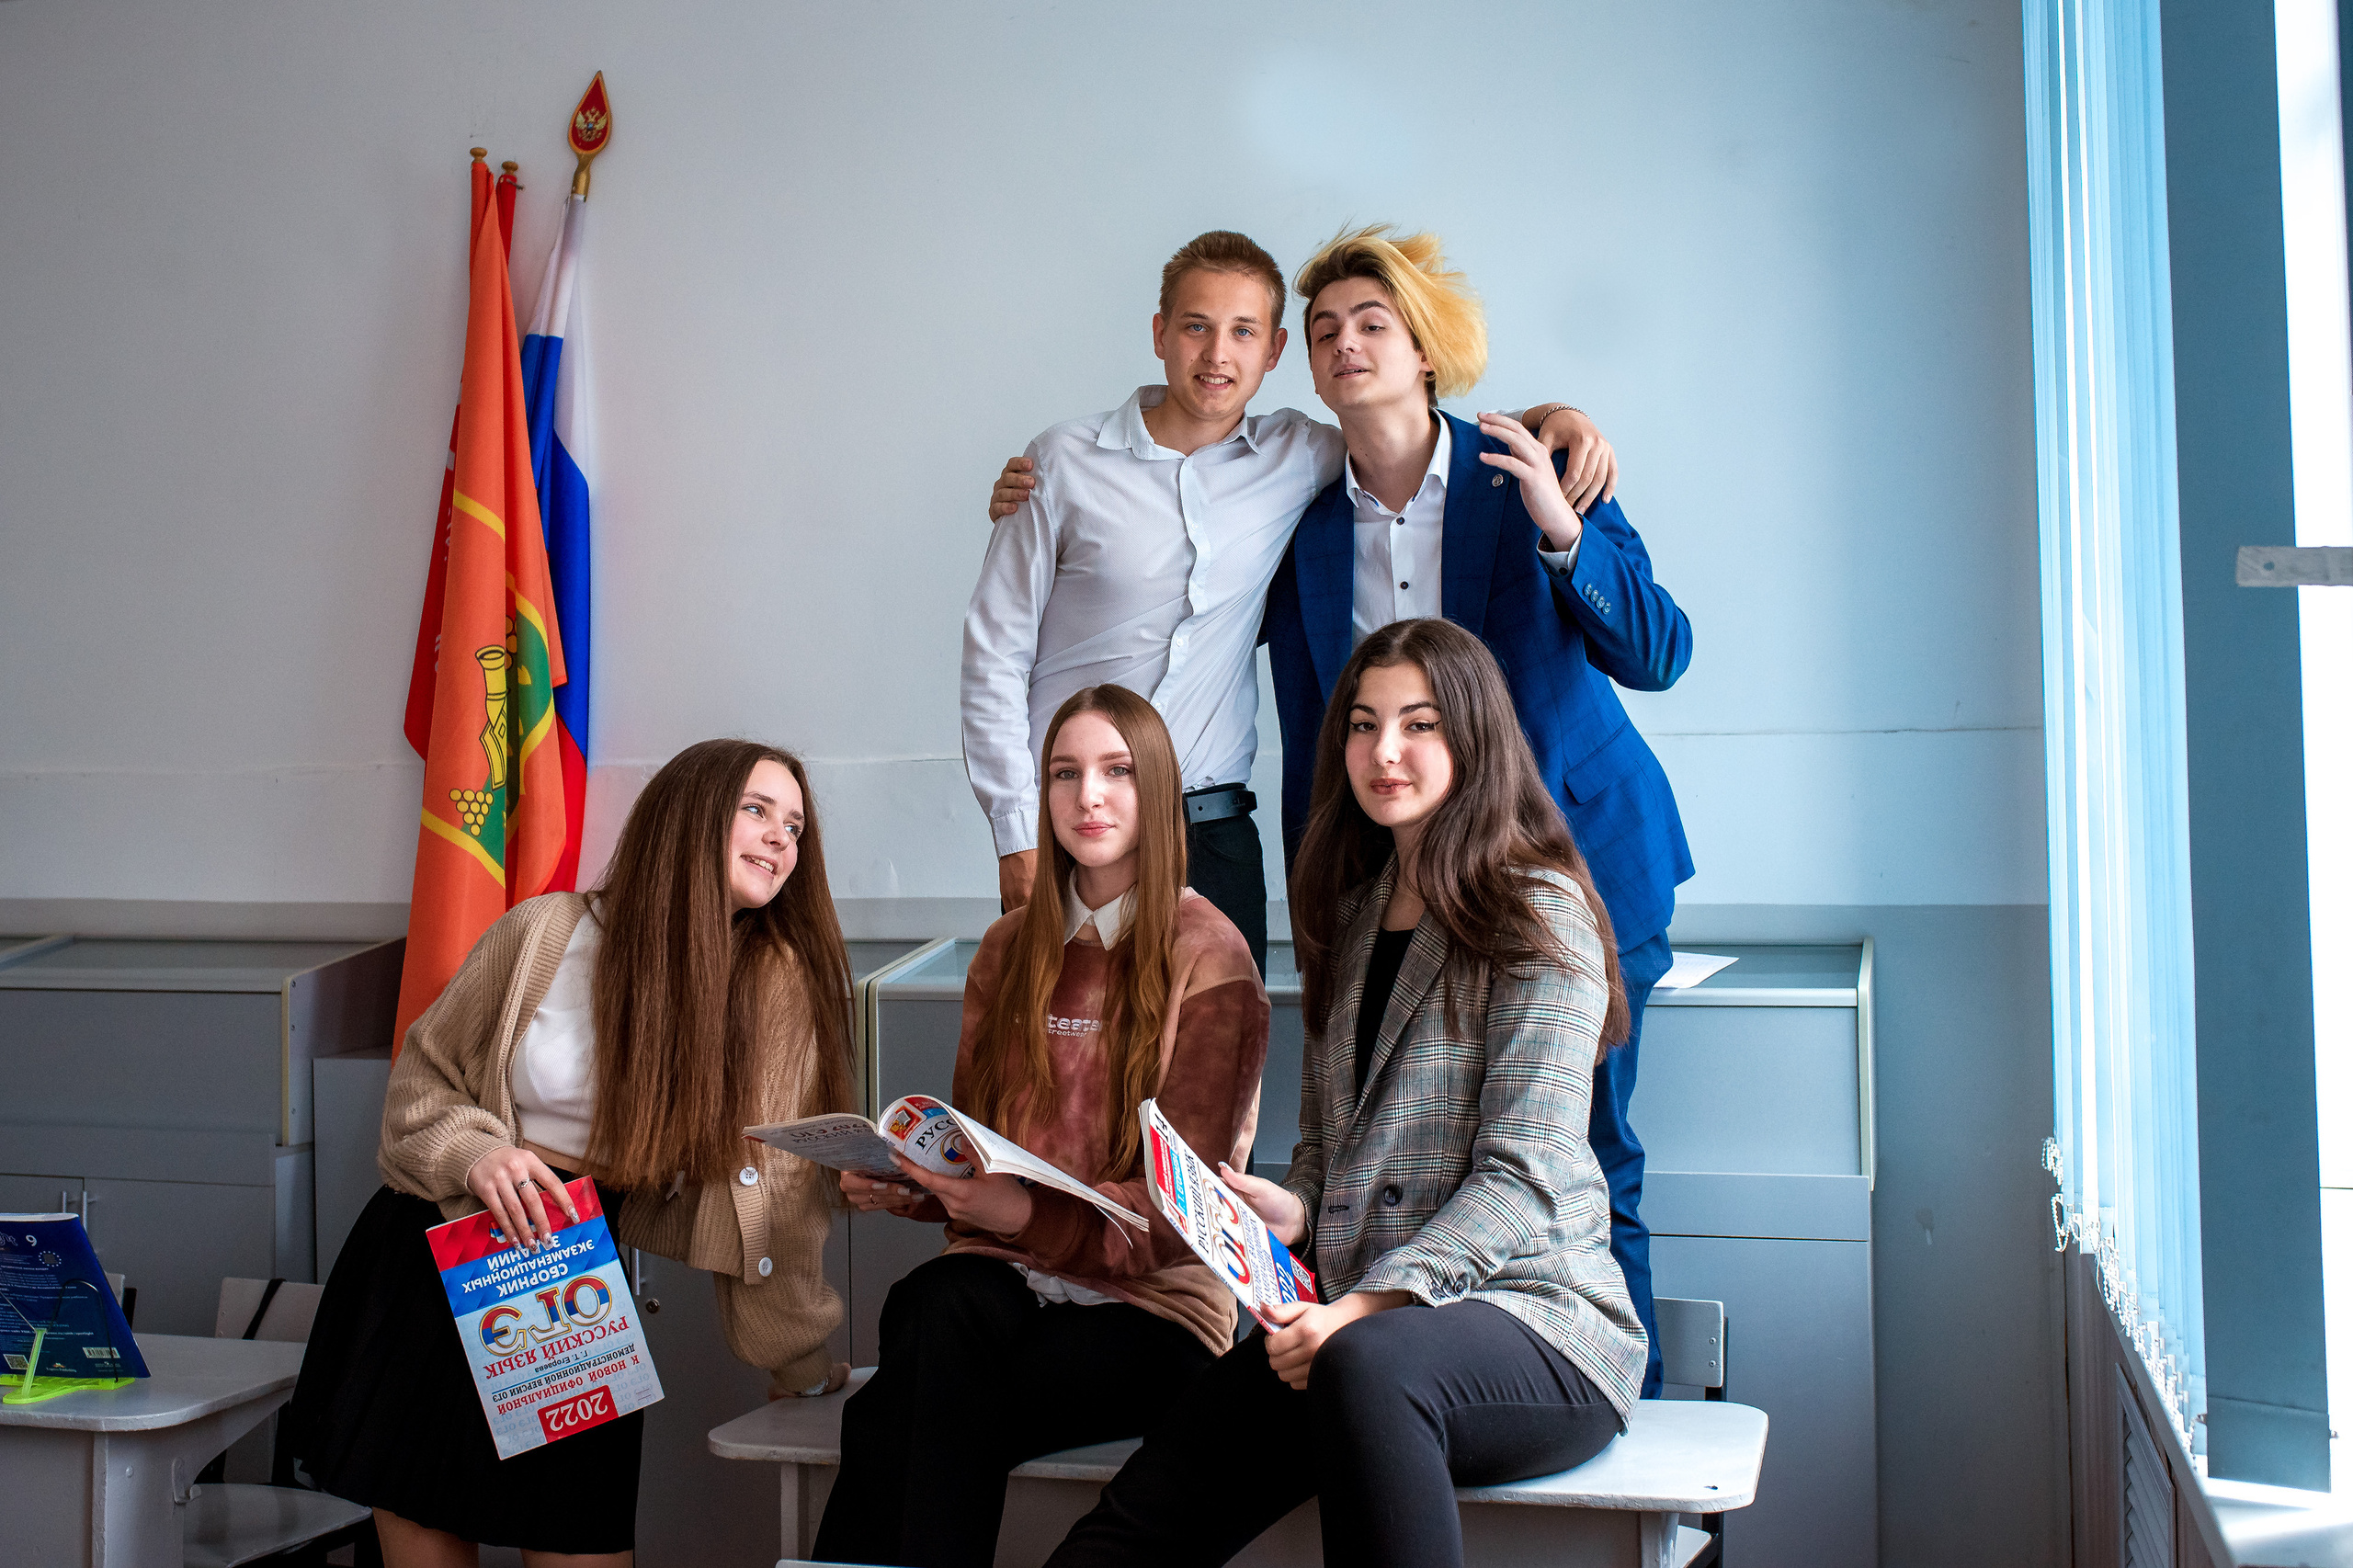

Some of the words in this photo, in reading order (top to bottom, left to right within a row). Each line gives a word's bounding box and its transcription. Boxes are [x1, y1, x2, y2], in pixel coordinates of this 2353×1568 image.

[1048, 1028, 1086, 1037] treetwear
[915, 1119, 957, 1150] РУСС
[1154, 1113, 1169, 1142] 14
[1184, 1148, 1199, 1190] ЯЗЫК
[1188, 1183, 1208, 1254] РУССКИЙ
[1202, 1178, 1251, 1287] ОГЭ
[26, 1235, 37, 1246] 9
[486, 1235, 561, 1270] ЗАНИЙ
[461, 1239, 595, 1293] ЭКЗАМЕНАЦИОННЫХ
[495, 1263, 568, 1297] СБОРНИК
[1276, 1262, 1298, 1303] 022
[478, 1276, 612, 1357] ОГЭ
[541, 1315, 630, 1358] РУССКИЙ
[580, 1349, 588, 1358] Г.
[483, 1348, 538, 1380] ЯЗЫК
[534, 1356, 570, 1373] Егораева
[544, 1343, 635, 1384] ДЕМОНСТРАЦИОННОЙ
[588, 1359, 626, 1382] НОВОЙ
[631, 1355, 640, 1365] К
[492, 1391, 507, 1402] ОГЭ
[496, 1377, 583, 1415] ОФИЦИАЛЬНОЙ
[509, 1378, 542, 1398] ВЕРСИИ
[545, 1391, 608, 1432] 2022
